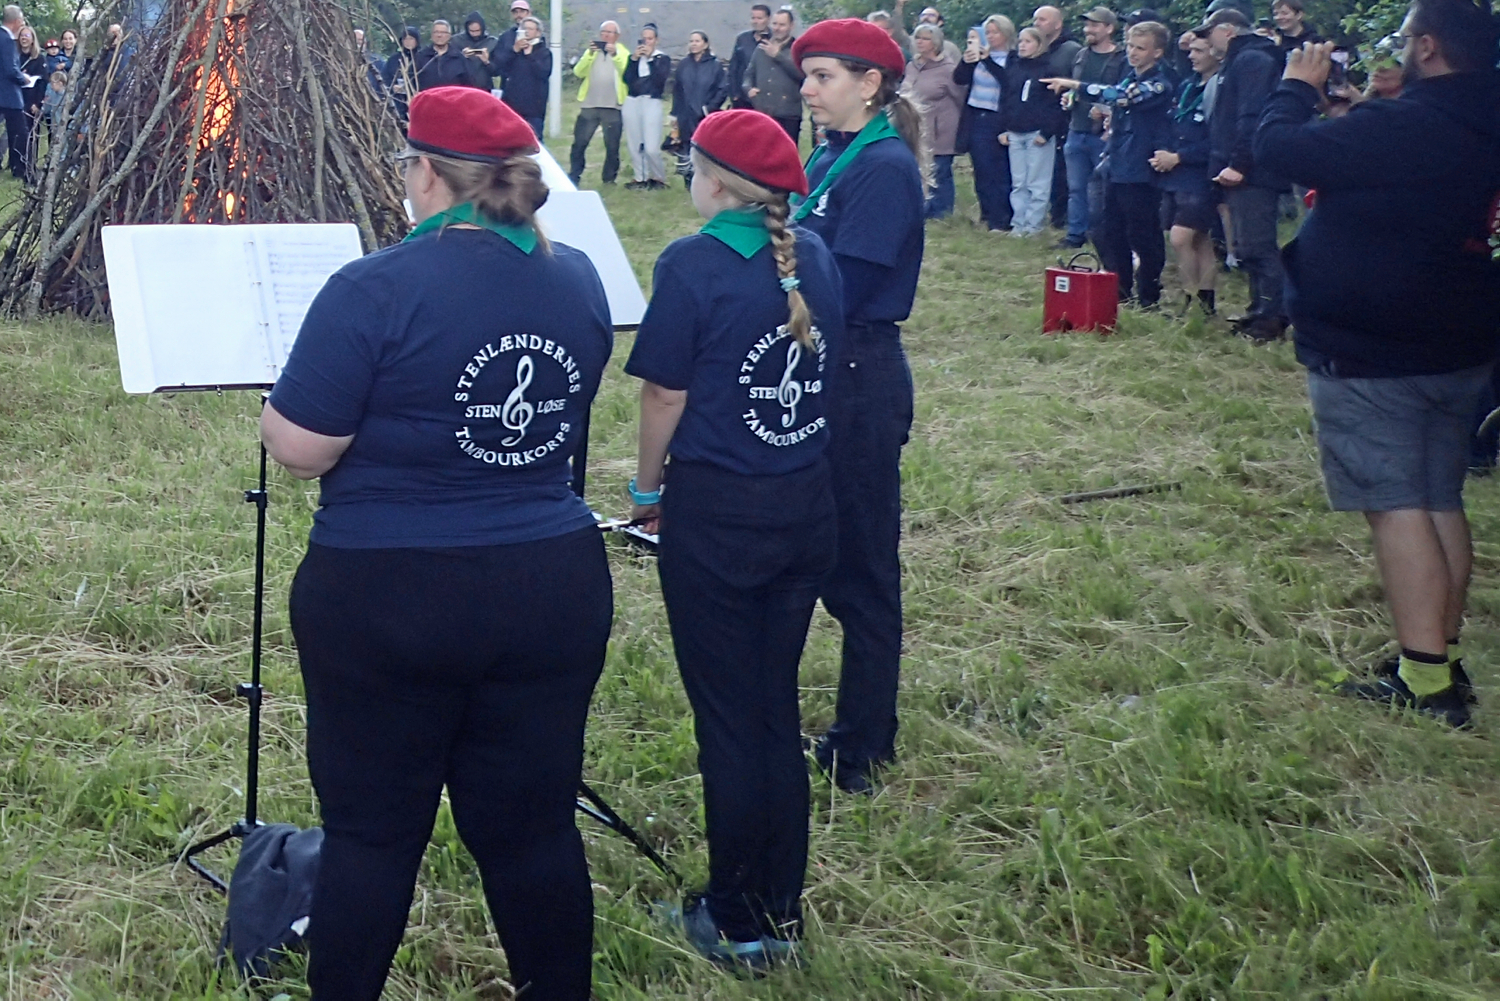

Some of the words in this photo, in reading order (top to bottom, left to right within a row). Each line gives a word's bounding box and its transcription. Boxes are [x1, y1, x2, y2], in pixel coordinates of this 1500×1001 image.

[454, 333, 581, 402] STENLÆNDERNES
[465, 404, 501, 418] STEN
[536, 398, 567, 414] LØSE
[454, 422, 571, 466] TAMBOURKORPS
